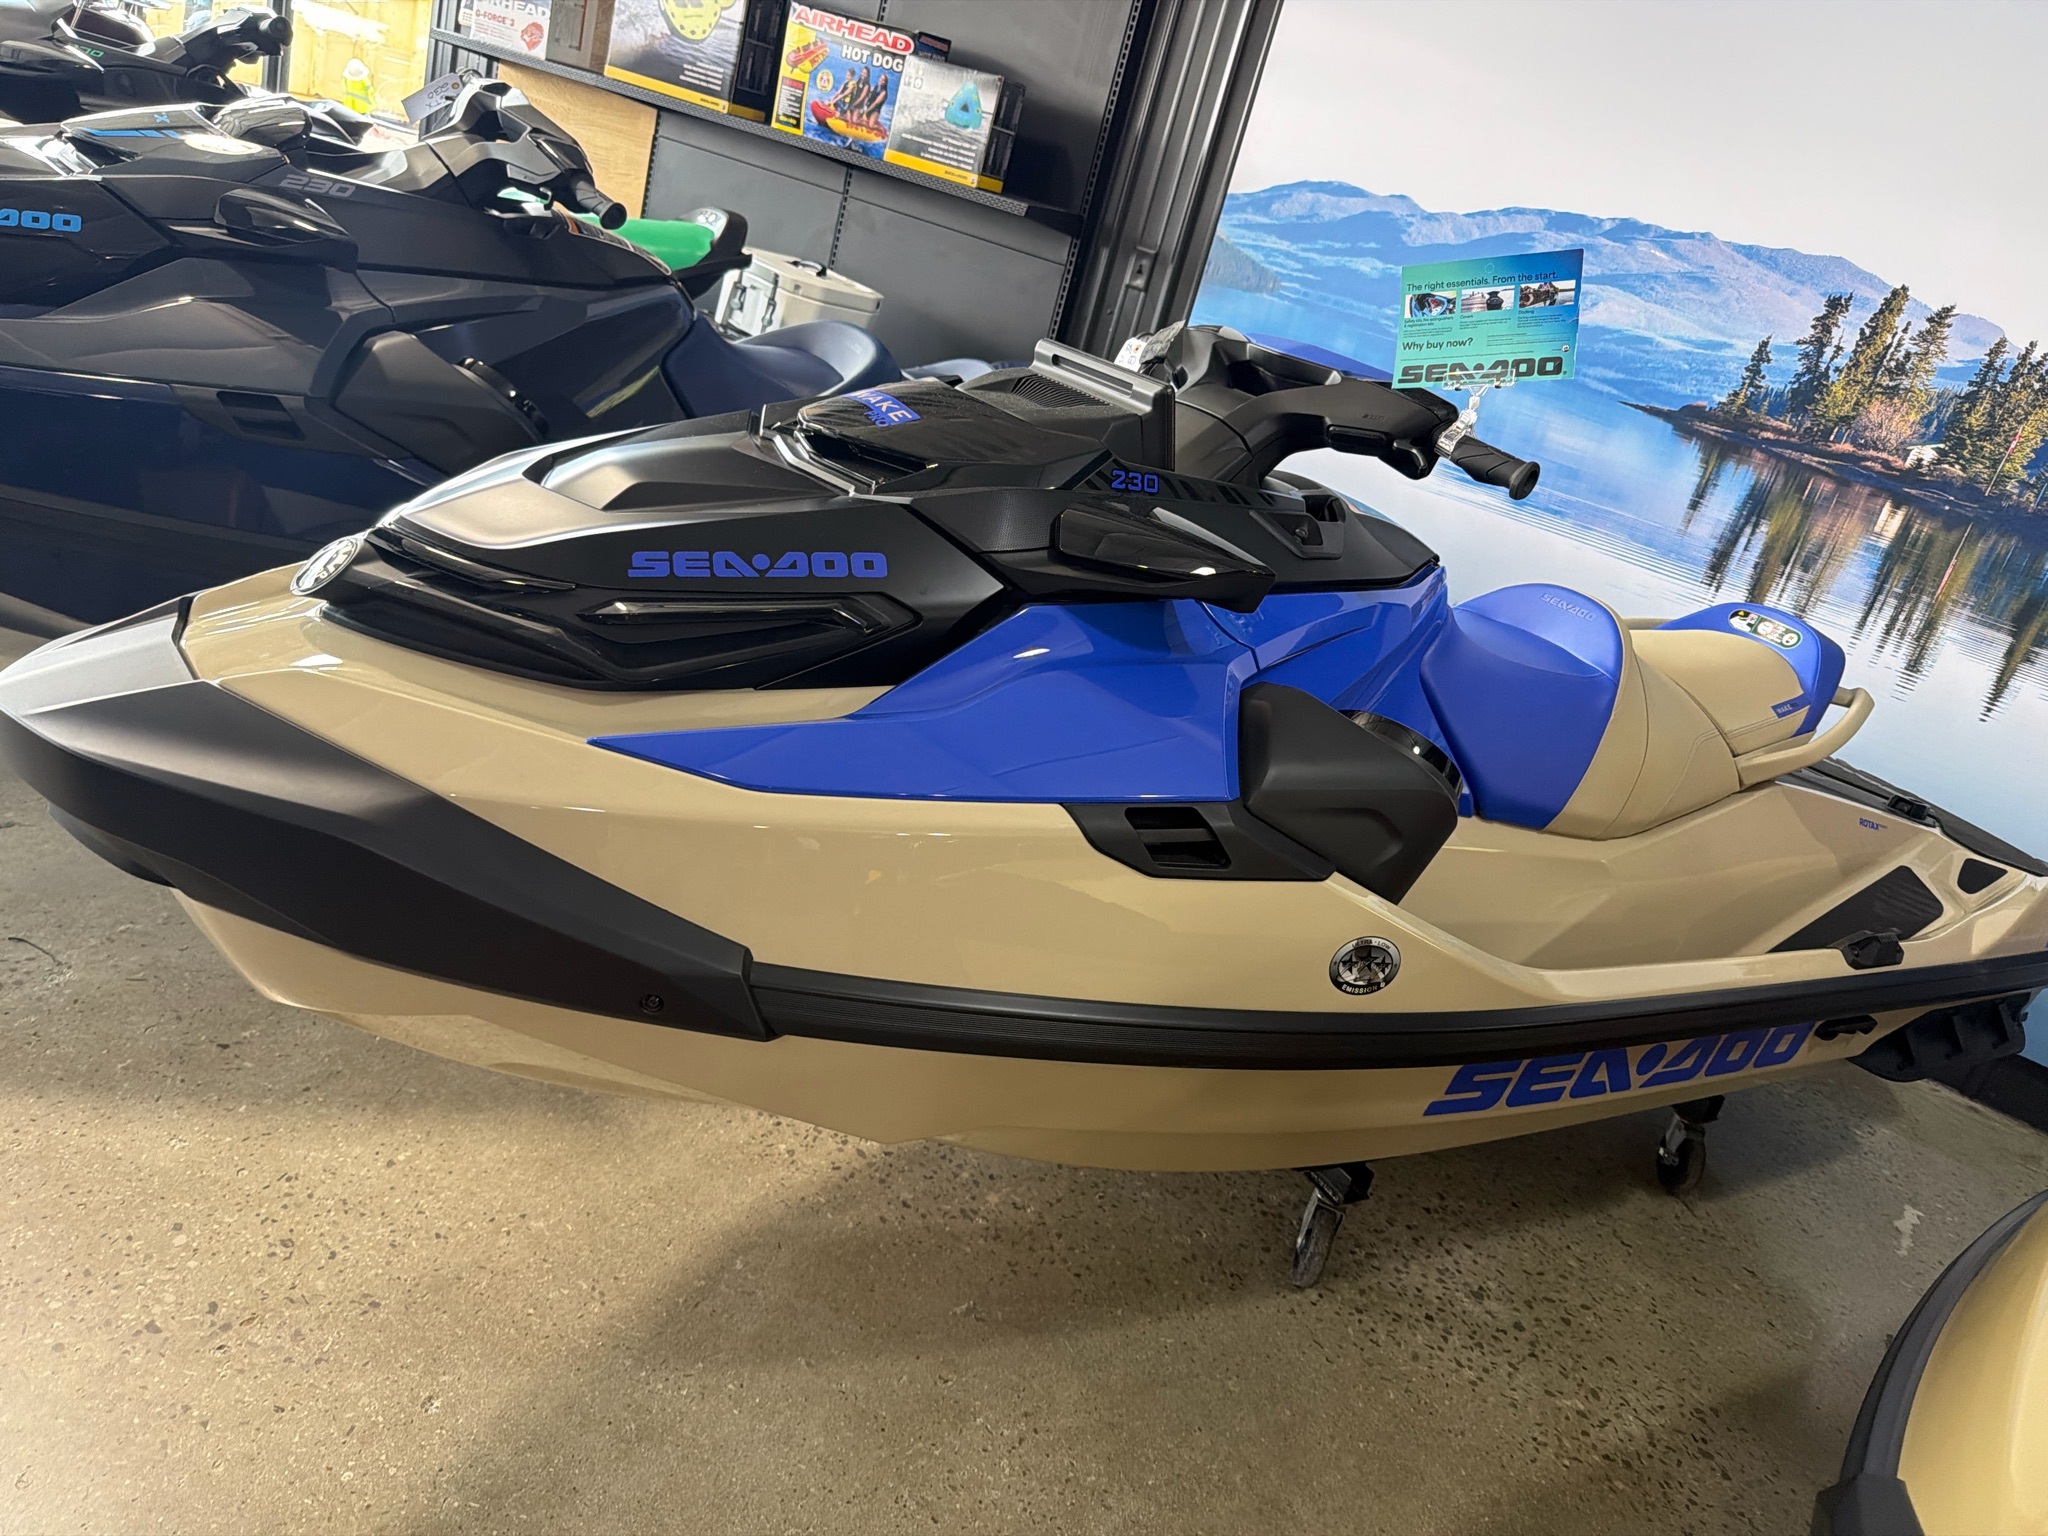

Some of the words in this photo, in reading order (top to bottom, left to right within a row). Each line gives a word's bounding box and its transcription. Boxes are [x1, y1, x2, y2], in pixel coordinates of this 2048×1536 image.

[793, 8, 914, 53] AIRHEAD
[841, 44, 871, 63] HOT
[873, 53, 904, 72] DOG
[279, 174, 356, 197] 230
[1407, 283, 1422, 292] The
[1424, 281, 1445, 291] right
[1446, 276, 1490, 288] essentials.
[1493, 275, 1515, 284] From
[1518, 273, 1533, 281] the
[1535, 270, 1558, 280] start.
[1402, 341, 1424, 352] Why
[1426, 339, 1444, 351] buy
[1446, 337, 1473, 348] now?
[1111, 469, 1159, 493] 230
[1377, 940, 1391, 950] LOW
[1341, 983, 1378, 994] EMISSION
